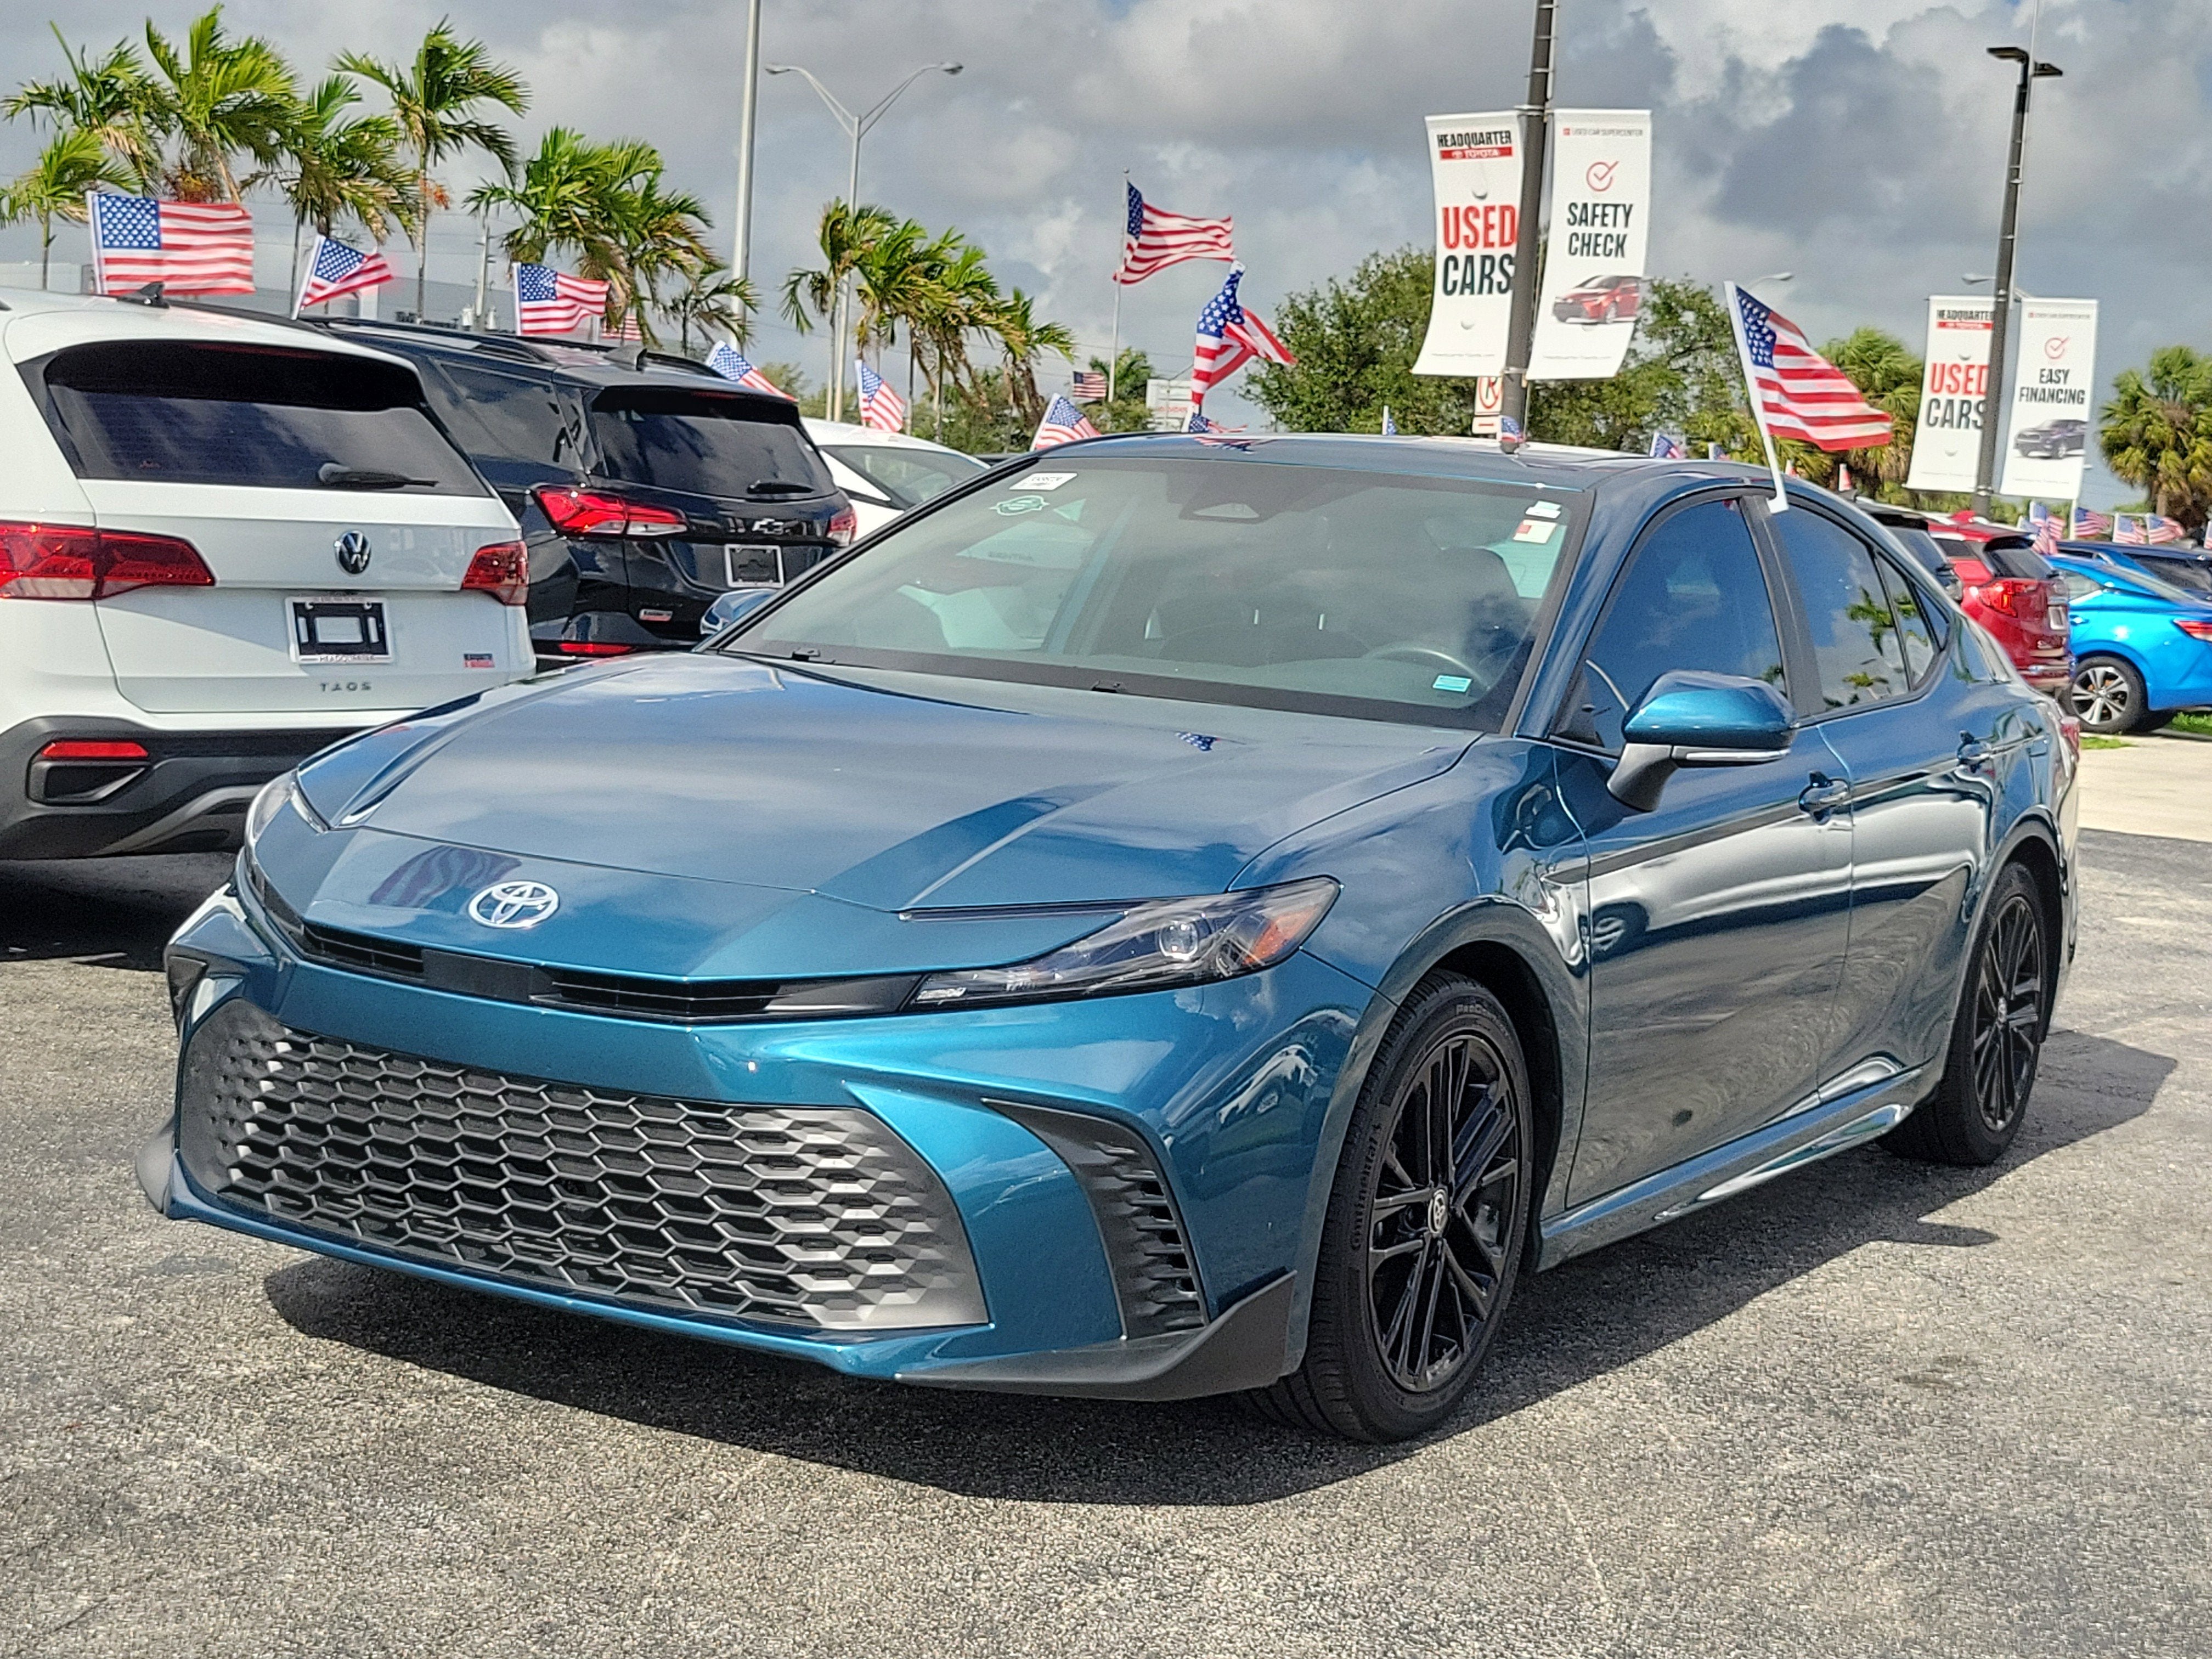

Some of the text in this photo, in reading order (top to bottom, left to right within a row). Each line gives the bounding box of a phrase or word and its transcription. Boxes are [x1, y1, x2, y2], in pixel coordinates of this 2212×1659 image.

[1437, 130, 1512, 149] HEADQUARTER
[1442, 204, 1517, 250] USED
[1567, 202, 1633, 228] SAFETY
[1568, 232, 1628, 258] CHECK
[1442, 253, 1514, 296] CARS
[1931, 363, 1990, 395] USED
[2039, 368, 2070, 385] EASY
[2019, 386, 2086, 405] FINANCING
[1926, 397, 1988, 430] CARS
[320, 682, 372, 692] TAOS
